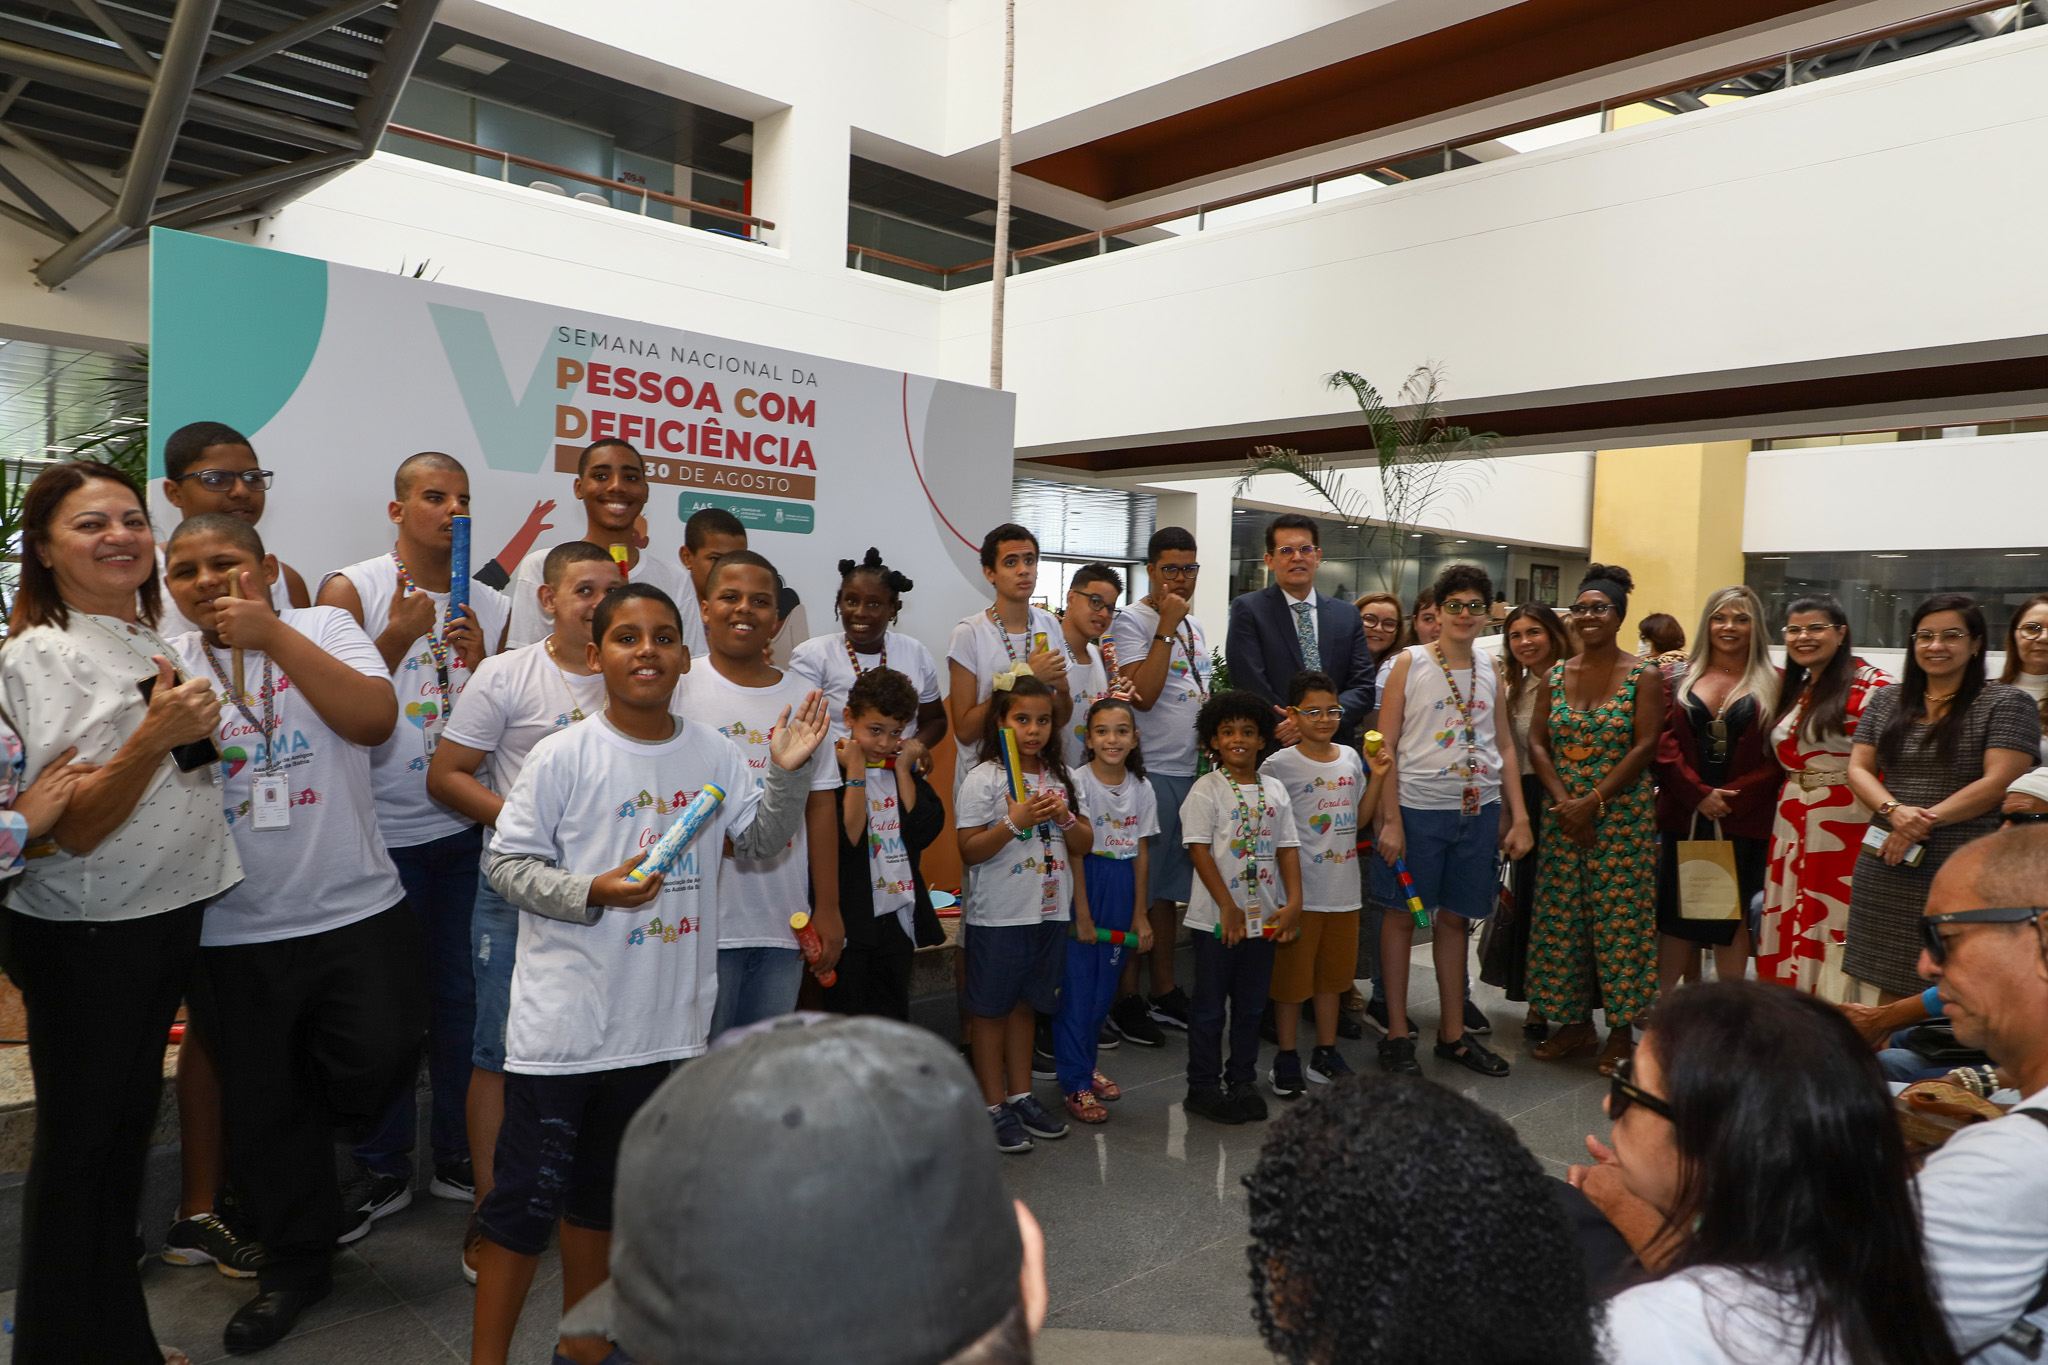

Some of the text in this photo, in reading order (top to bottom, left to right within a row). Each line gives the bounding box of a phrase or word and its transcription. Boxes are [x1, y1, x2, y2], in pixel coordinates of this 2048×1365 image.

[557, 325, 819, 388] SEMANA NACIONAL DA
[556, 356, 817, 428] PESSOA COM
[555, 404, 818, 471] DEFICIÊNCIA
[644, 461, 791, 493] 30 DE AGOSTO
[253, 729, 310, 766] AMA
[292, 758, 310, 767] Bahia
[1317, 798, 1341, 811] Coral
